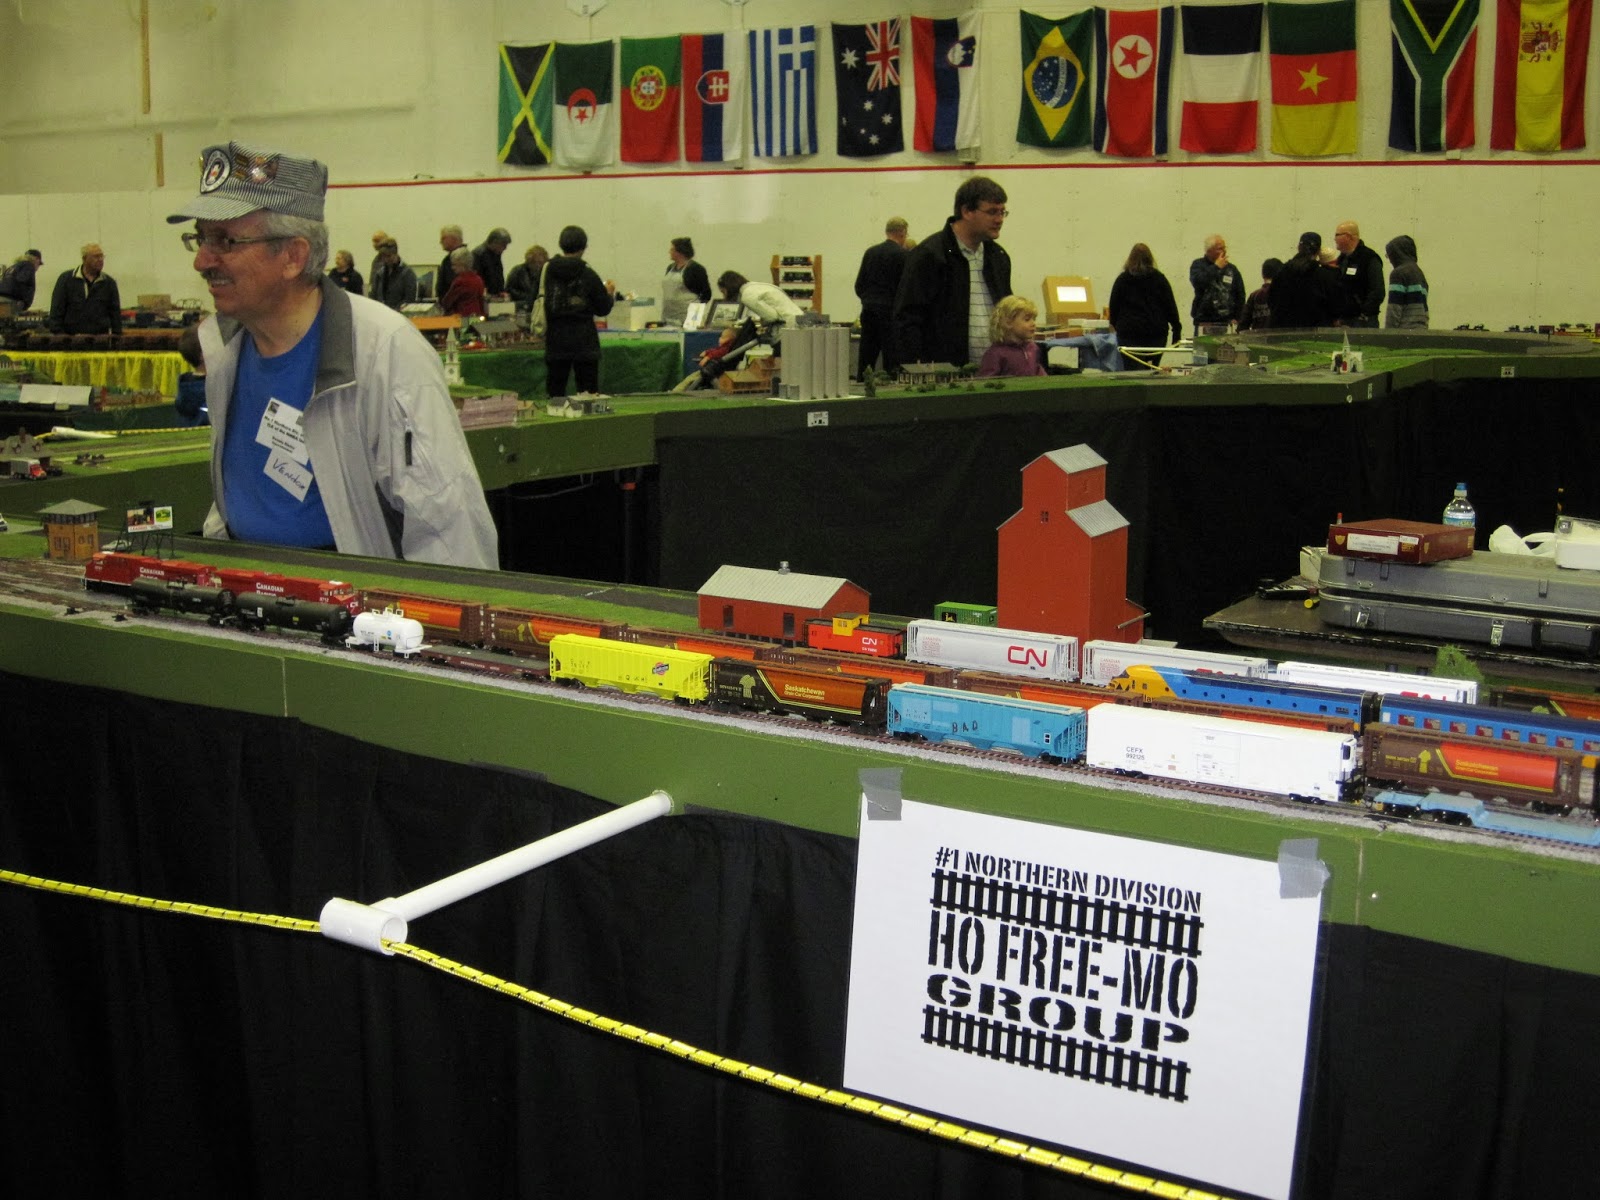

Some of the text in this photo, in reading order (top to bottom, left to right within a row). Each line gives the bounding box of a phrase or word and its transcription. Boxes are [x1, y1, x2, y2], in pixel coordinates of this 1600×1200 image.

[255, 582, 284, 593] CANADIAN
[862, 637, 878, 646] CN
[1007, 645, 1048, 668] CN
[784, 683, 825, 696] Saskatchewan
[1126, 746, 1142, 754] CEFX
[935, 846, 1202, 914] #1 NORTHERN DIVISION
[927, 909, 1199, 1020] HO FREE-MO
[926, 973, 1190, 1052] GROUP
